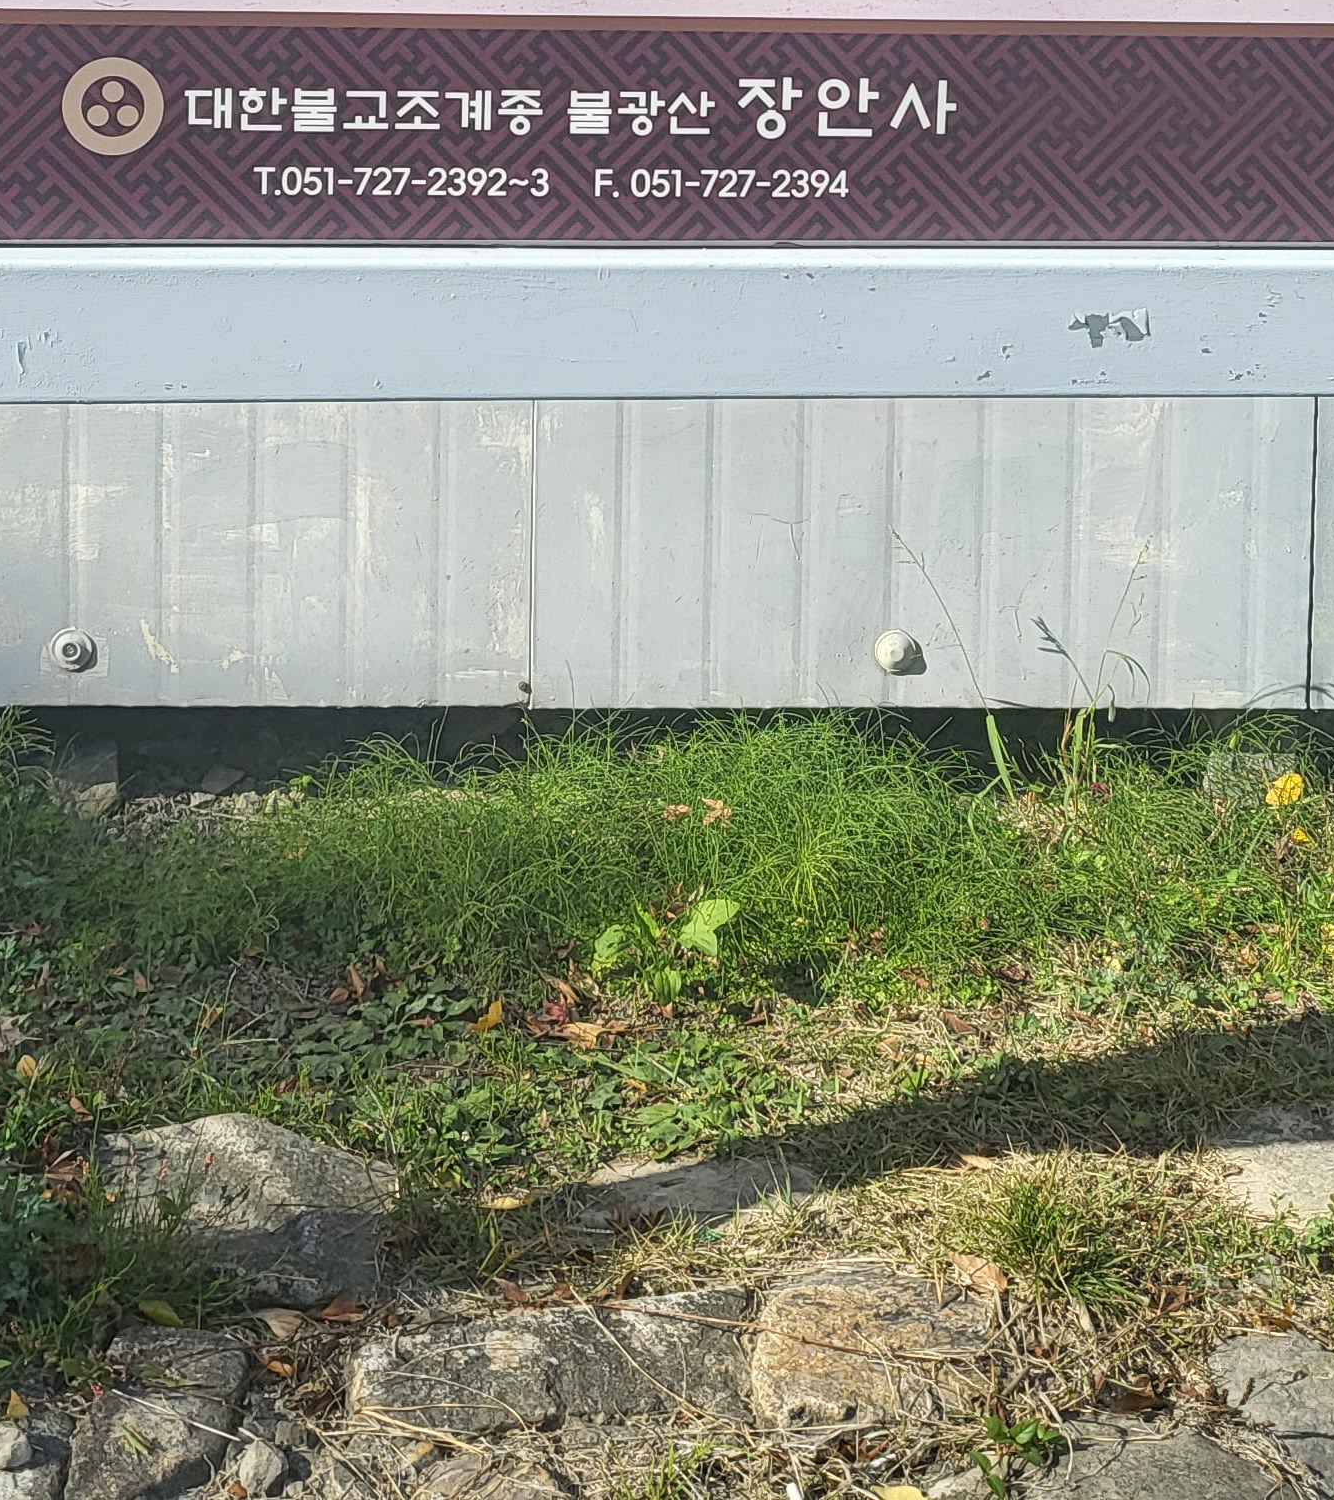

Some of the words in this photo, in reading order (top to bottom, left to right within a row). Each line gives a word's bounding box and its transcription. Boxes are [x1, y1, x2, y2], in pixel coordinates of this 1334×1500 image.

[183, 86, 545, 137] 대한불교조계종
[566, 89, 717, 137] 불광산
[736, 75, 958, 141] 장안사
[252, 165, 551, 198] T.051-727-2392~3
[593, 167, 621, 199] F.
[629, 167, 850, 199] 051-727-2394
